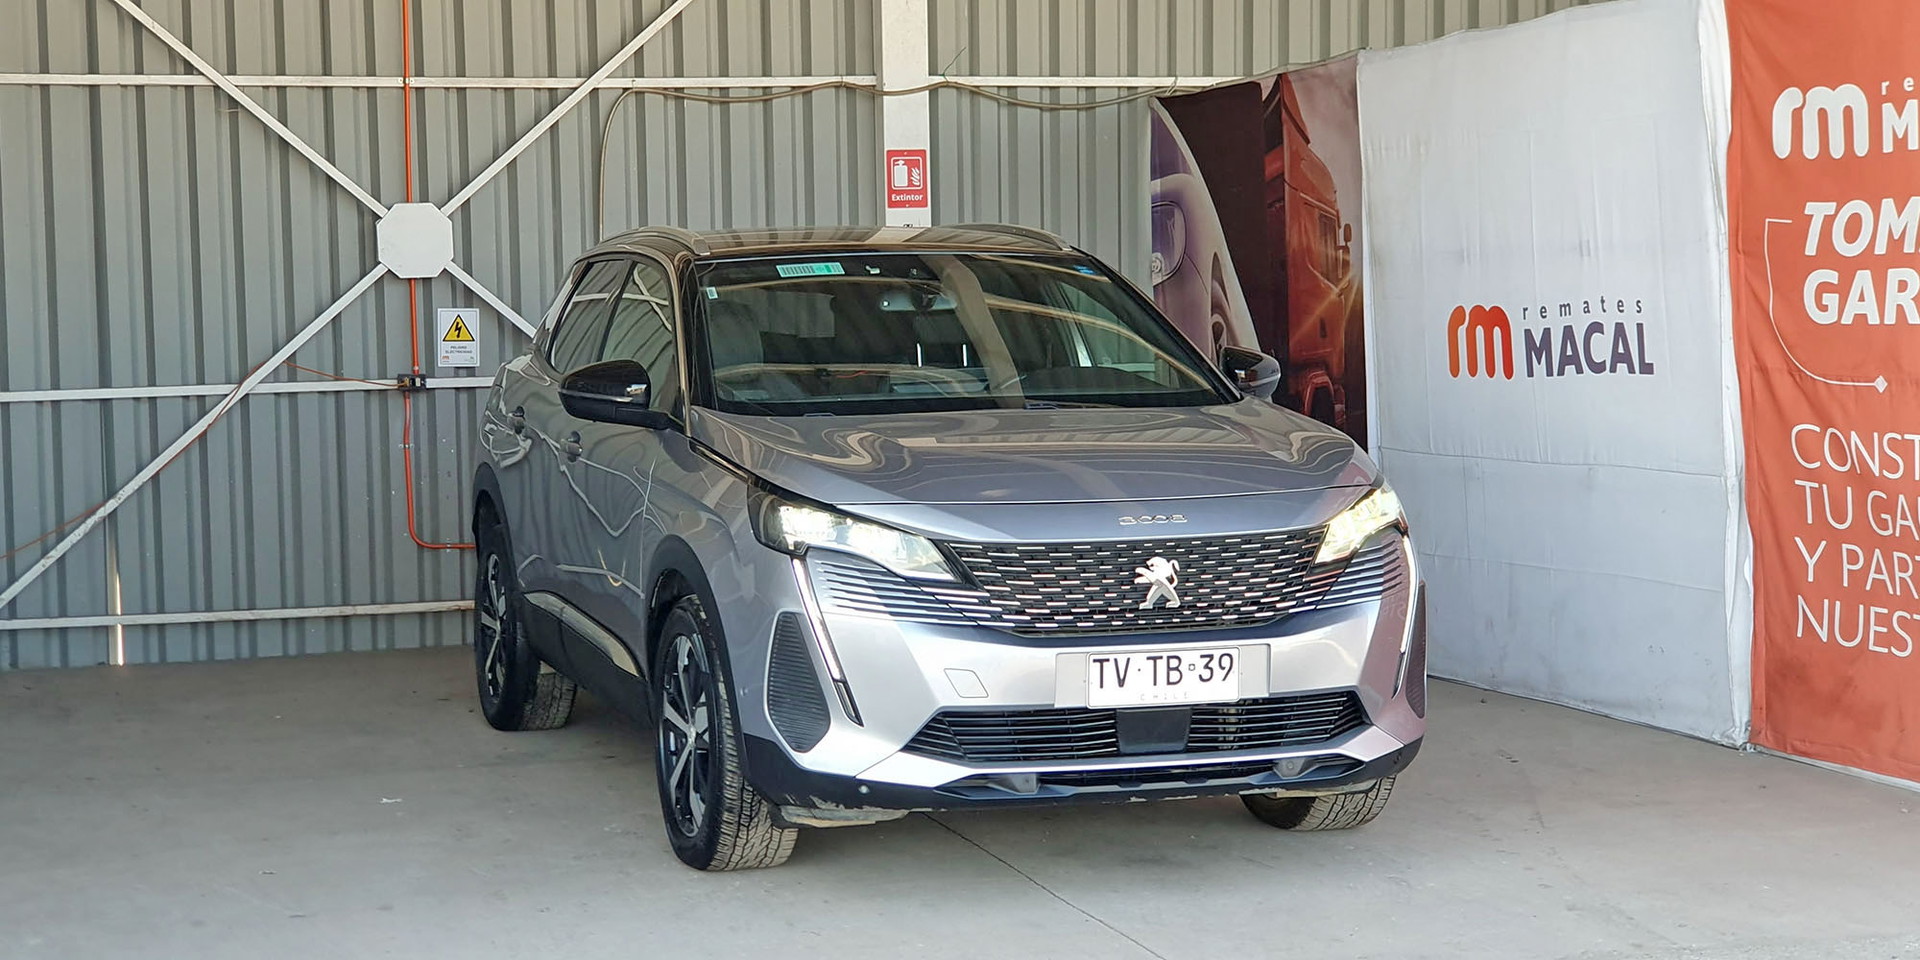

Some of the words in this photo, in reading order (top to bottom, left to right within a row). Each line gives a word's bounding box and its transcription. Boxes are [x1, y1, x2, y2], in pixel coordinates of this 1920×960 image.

[1881, 77, 1915, 96] re
[1881, 99, 1919, 154] M
[891, 193, 923, 202] Extintor
[1804, 195, 1920, 257] TOM
[1522, 295, 1643, 320] remates
[1803, 267, 1920, 325] GAR
[1523, 321, 1654, 378] MACAL
[1791, 423, 1920, 480] CONST
[1794, 479, 1852, 530] TU
[1867, 490, 1920, 541] GA
[1794, 536, 1827, 582] Y
[1841, 543, 1920, 599] PAR
[1796, 594, 1920, 658] NUES
